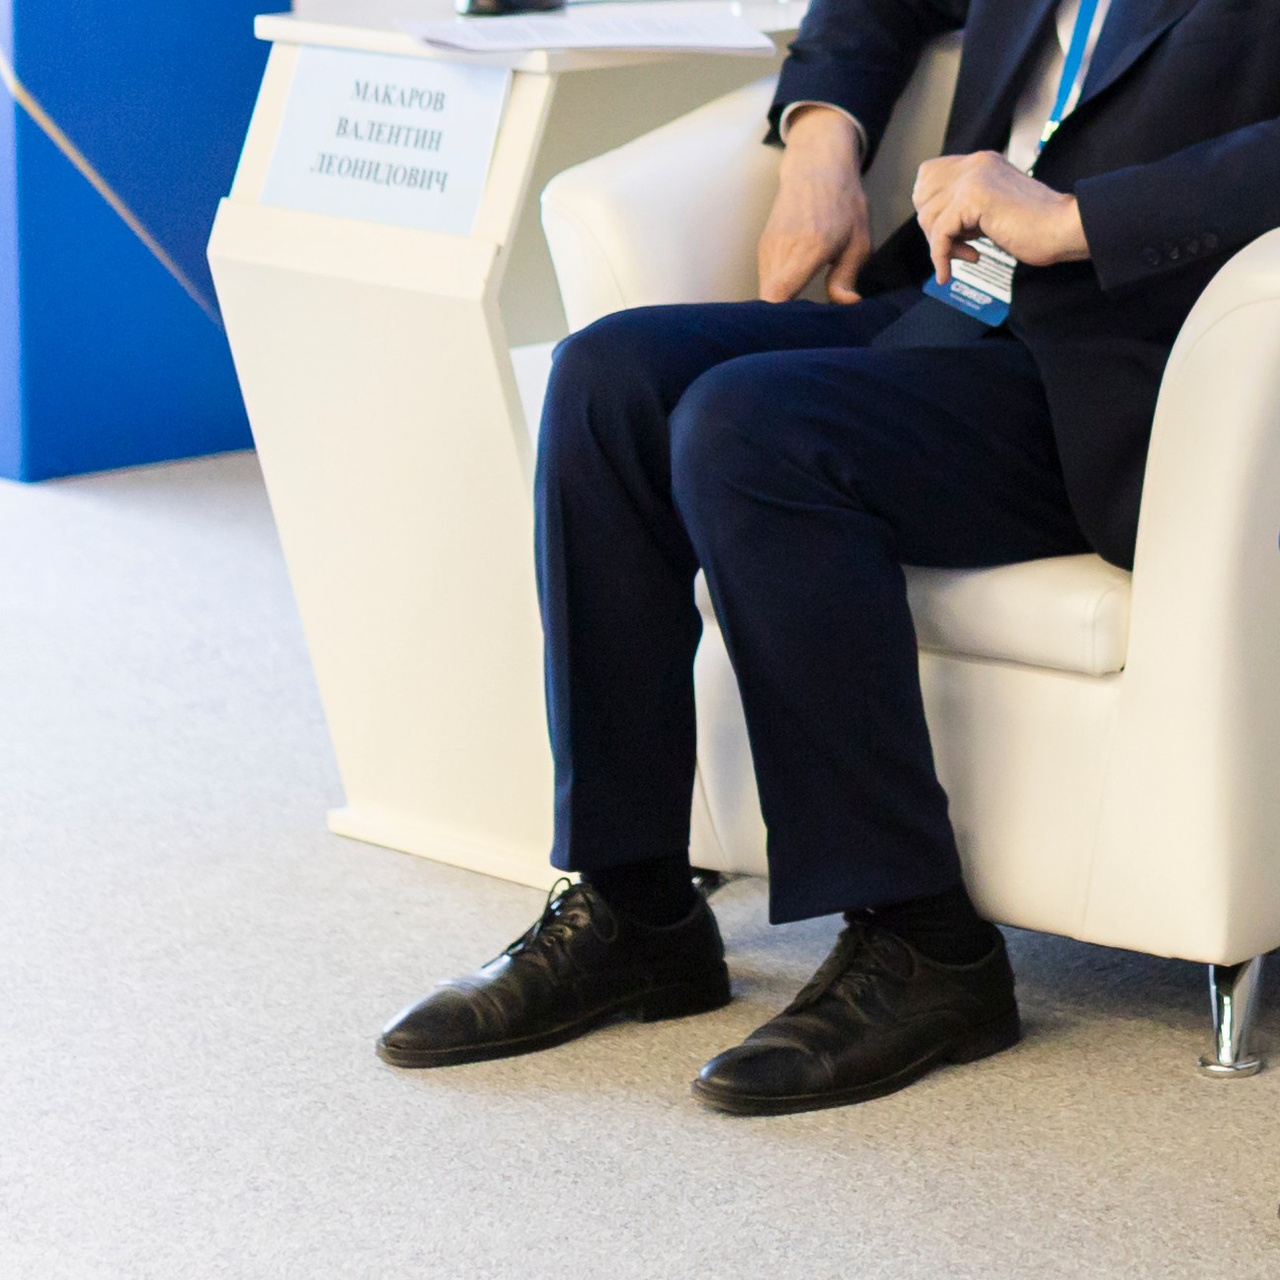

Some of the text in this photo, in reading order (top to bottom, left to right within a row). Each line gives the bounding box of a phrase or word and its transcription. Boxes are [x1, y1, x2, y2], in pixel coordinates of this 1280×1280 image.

[352, 80, 446, 112] МАКАРОВ
[336, 117, 442, 152] ВАЛЕНТИН
[310, 152, 448, 193] ЛЕОНИДОВИЧ
